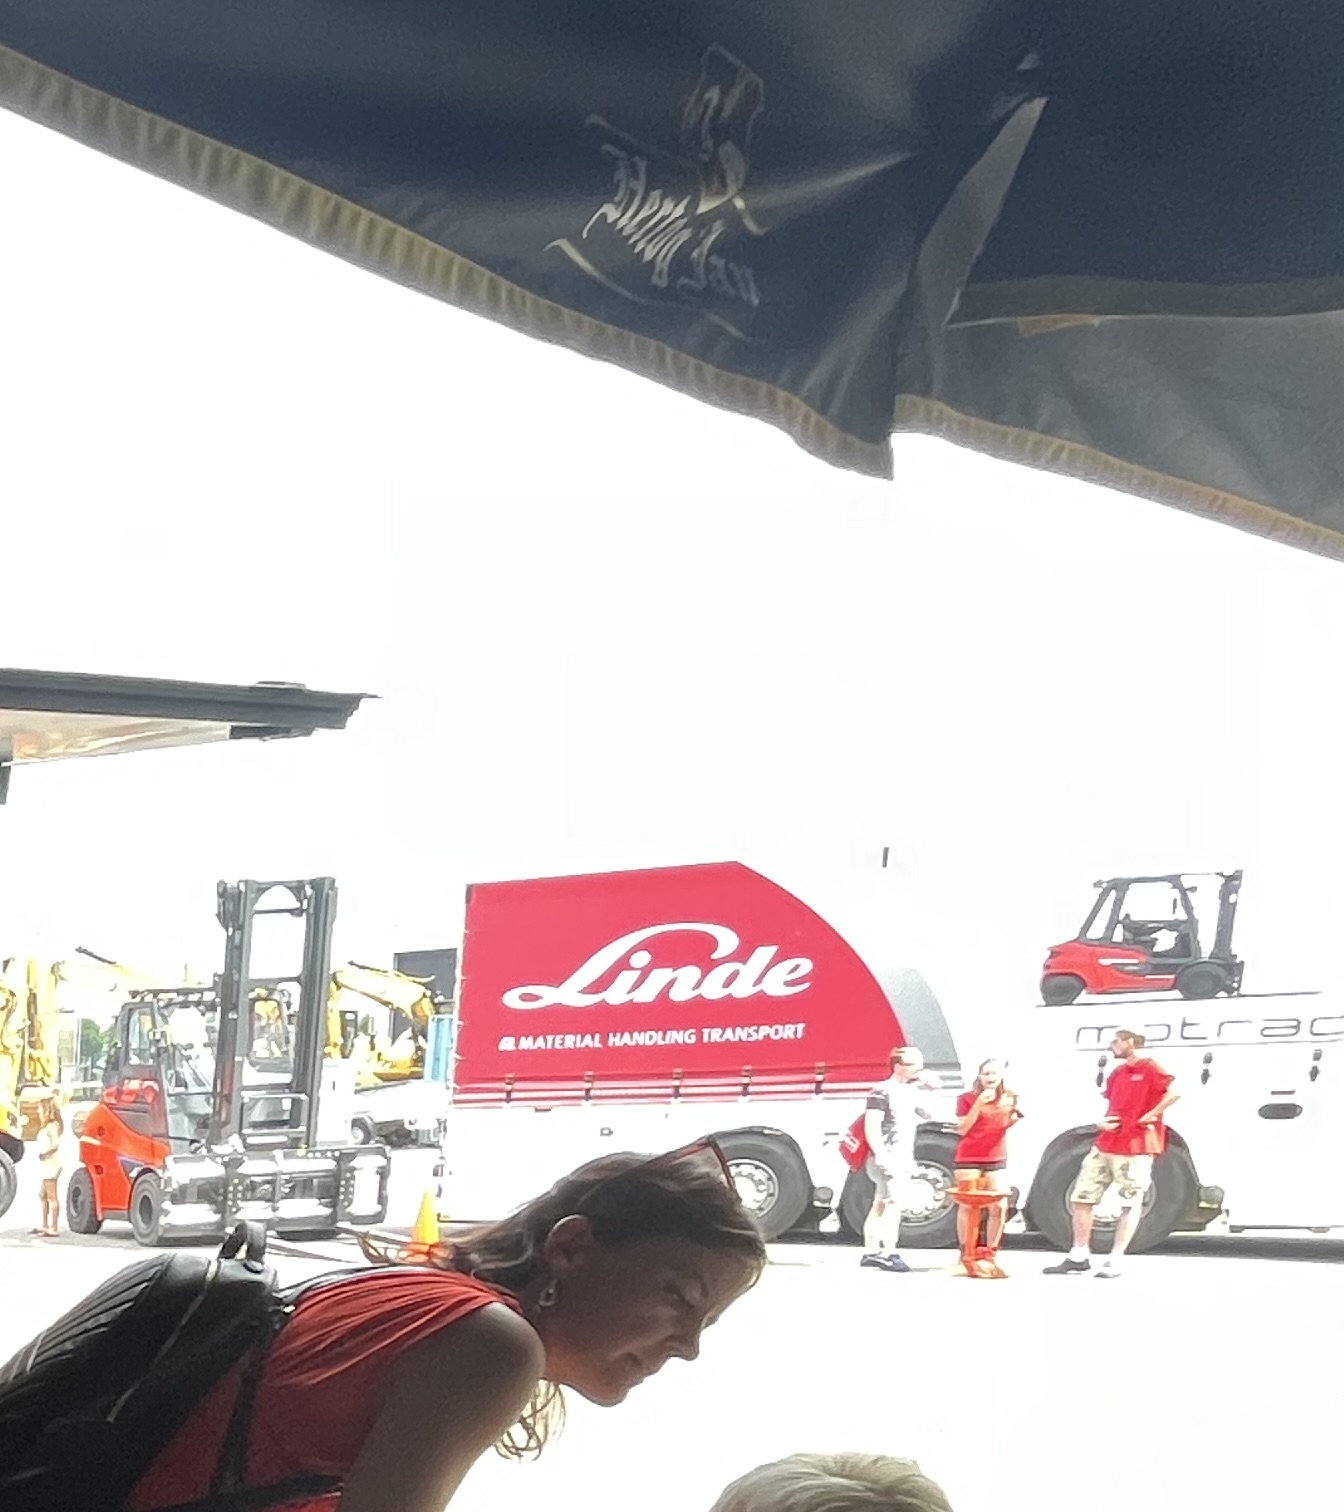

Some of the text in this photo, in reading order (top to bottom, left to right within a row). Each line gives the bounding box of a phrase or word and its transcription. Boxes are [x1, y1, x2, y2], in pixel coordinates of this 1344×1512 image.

[502, 921, 814, 1010] Linde
[518, 1032, 603, 1050] MATERIAL
[607, 1028, 697, 1046] HANDLING
[701, 1022, 806, 1043] TRANSPORT
